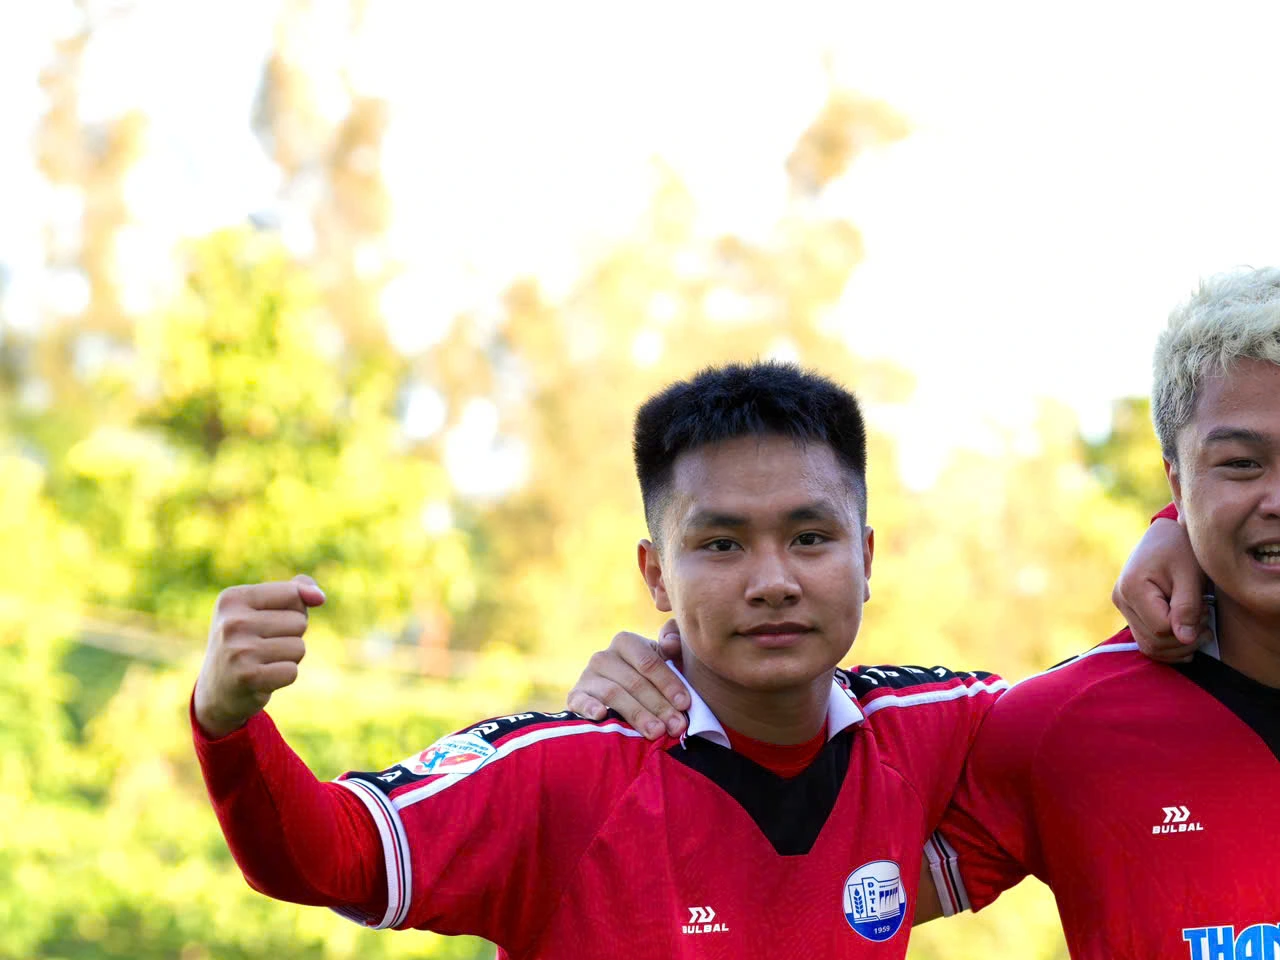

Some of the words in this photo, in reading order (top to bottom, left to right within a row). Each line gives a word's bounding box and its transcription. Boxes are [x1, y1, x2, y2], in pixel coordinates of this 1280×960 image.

[1152, 822, 1204, 835] BULBAL
[682, 923, 730, 934] BULBAL
[873, 925, 891, 935] 1959
